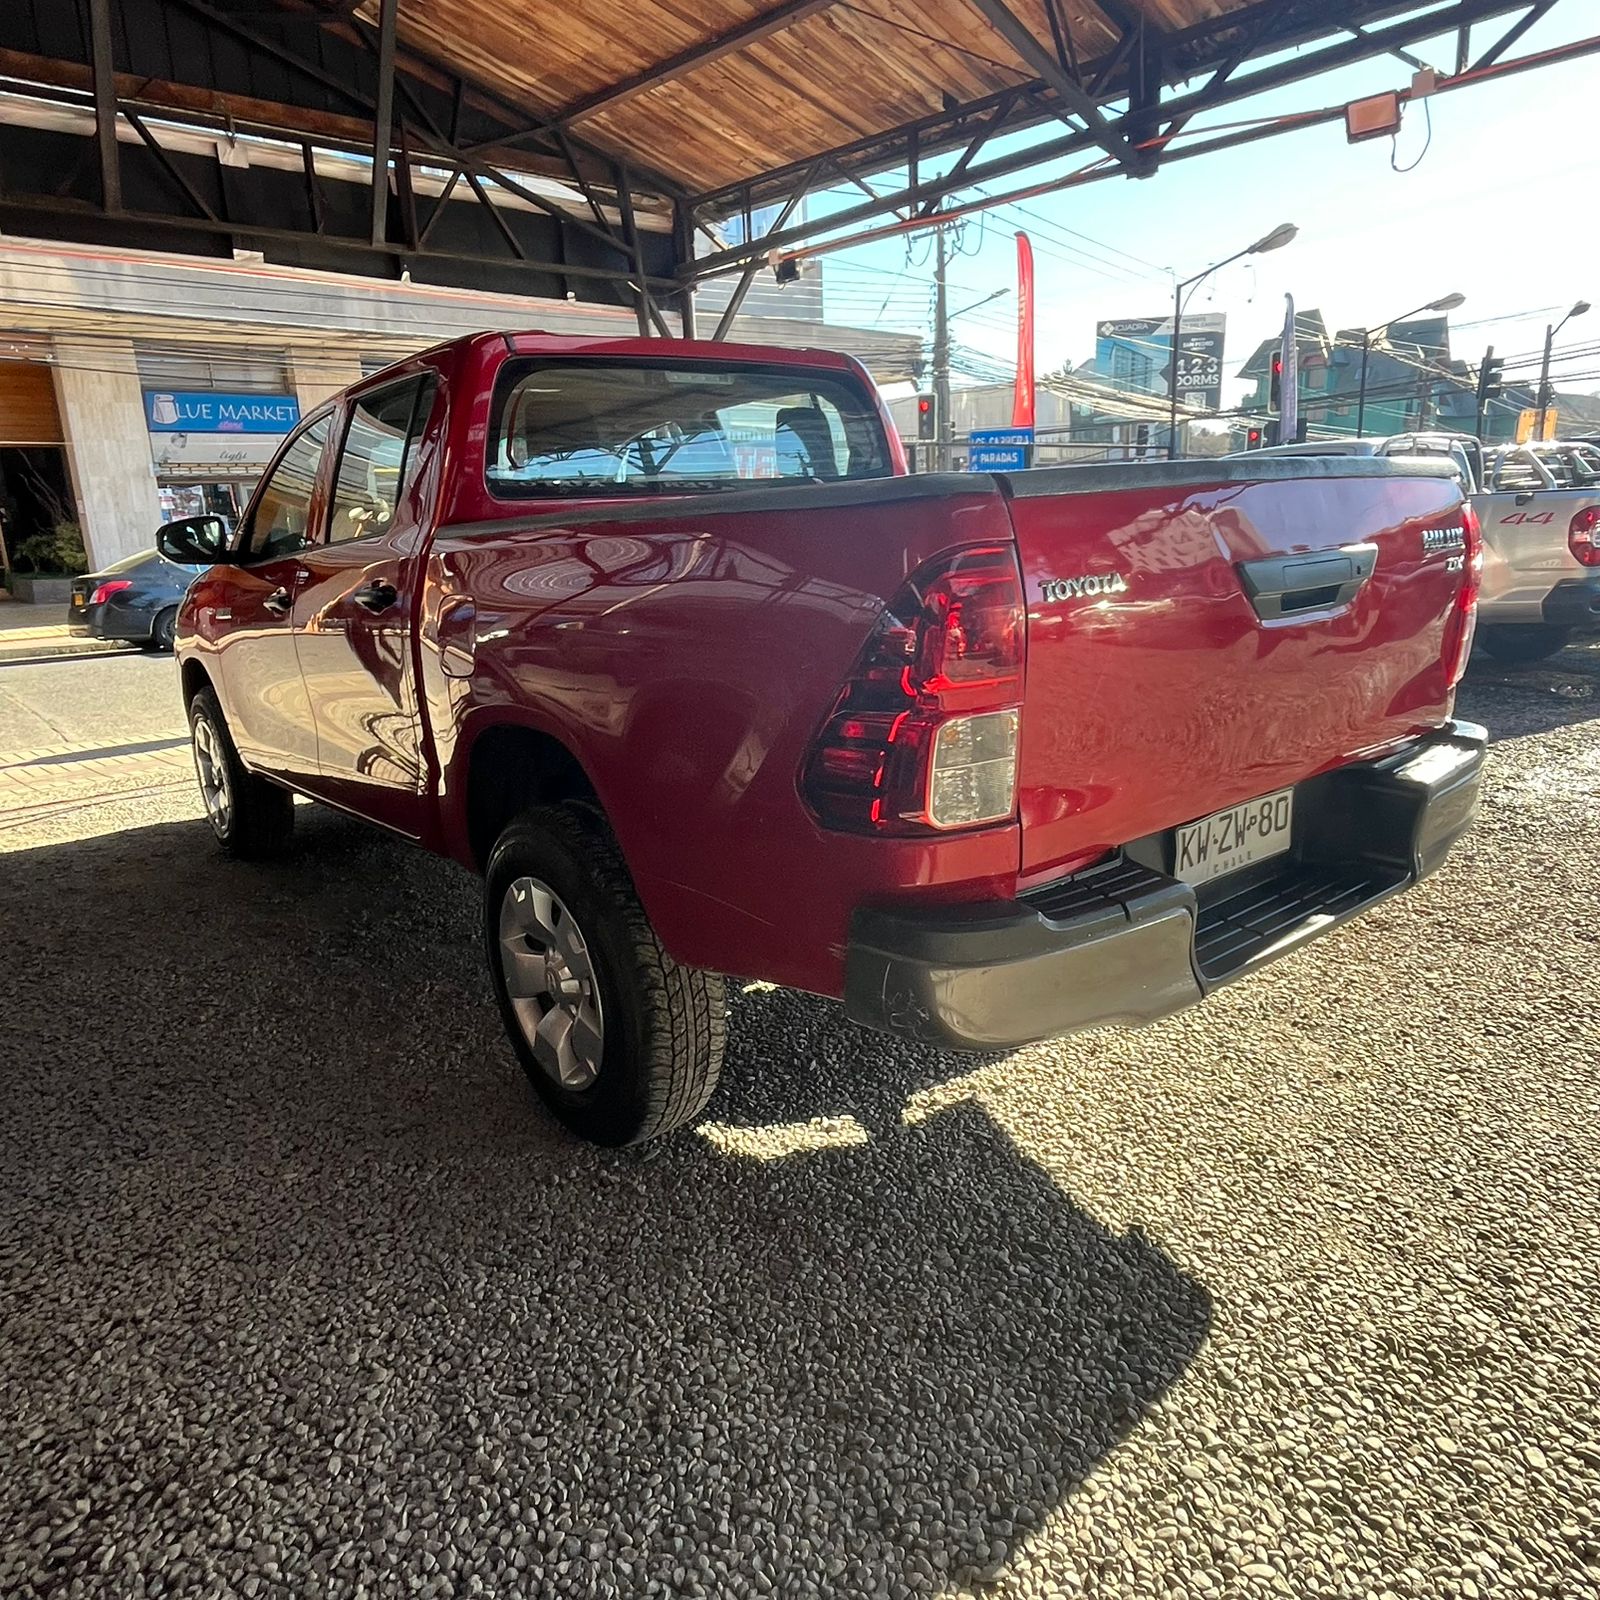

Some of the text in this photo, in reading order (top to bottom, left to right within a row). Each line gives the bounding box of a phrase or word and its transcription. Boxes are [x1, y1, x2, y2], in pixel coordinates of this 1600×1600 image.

[218, 403, 298, 421] MARKET
[980, 452, 1018, 463] PARADAS
[1037, 573, 1129, 603] TOYOTA
